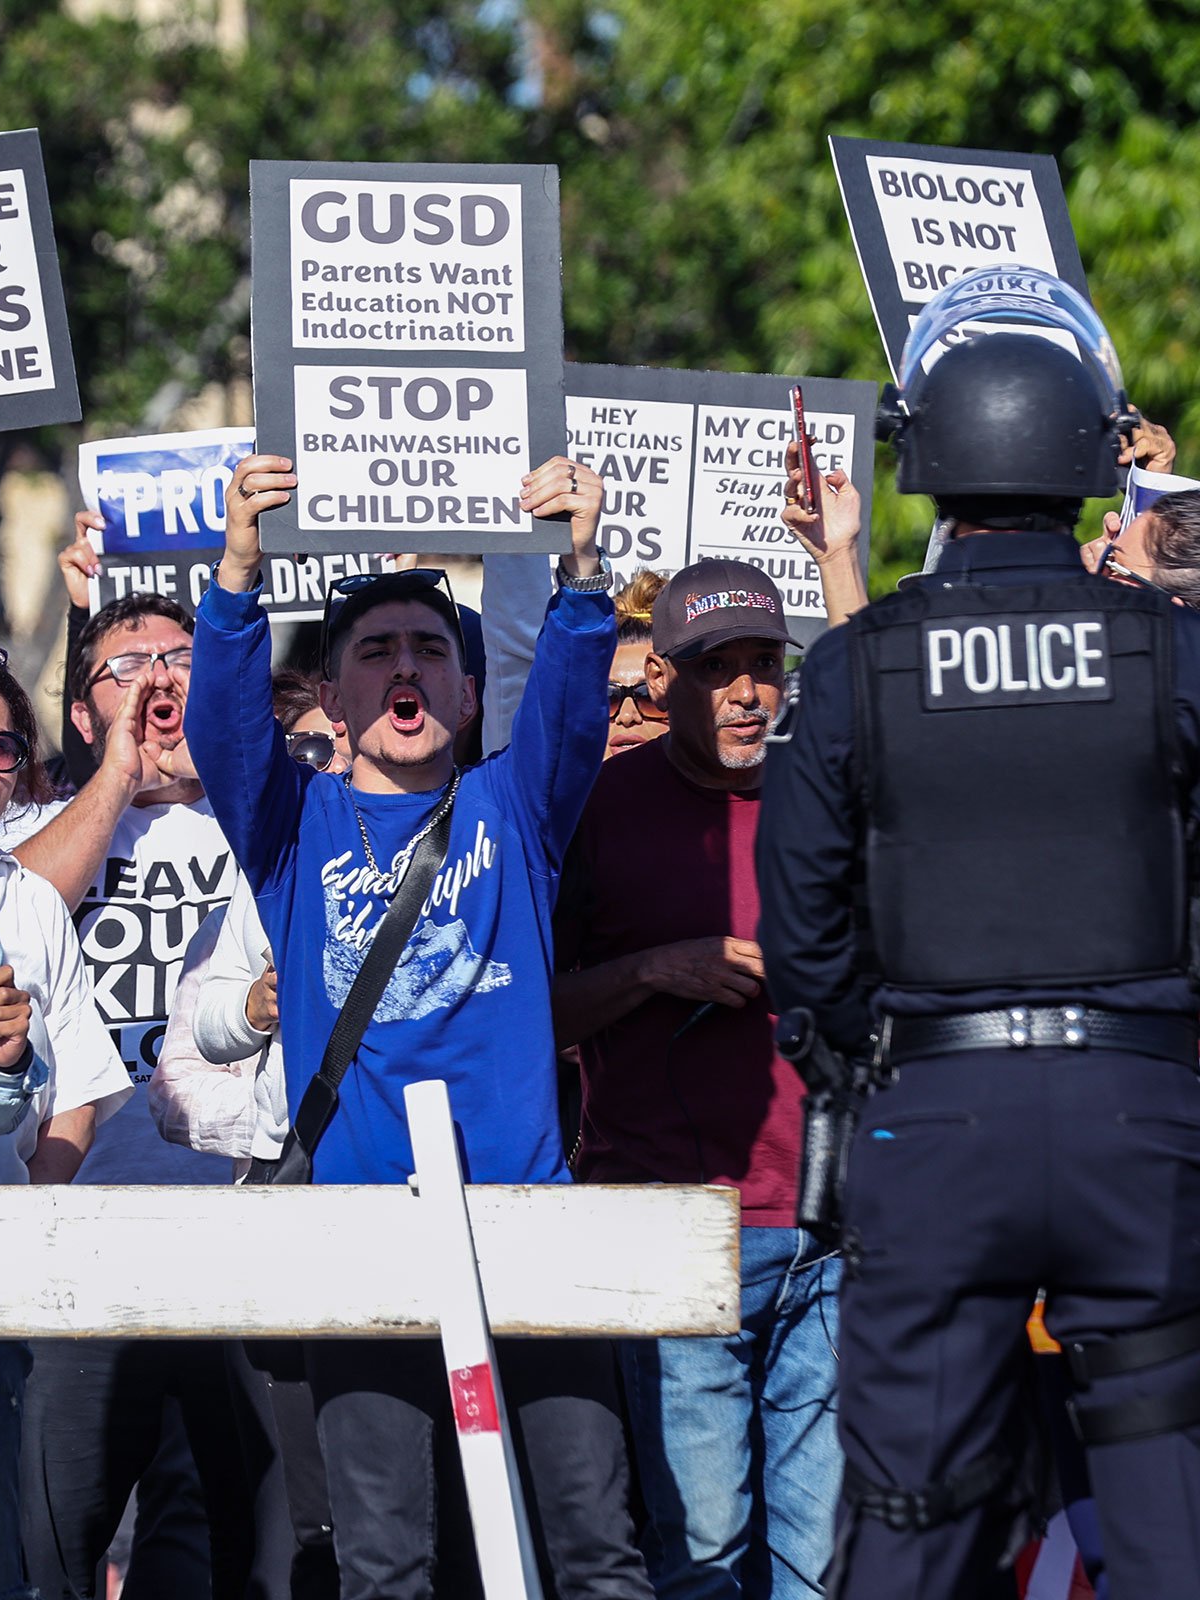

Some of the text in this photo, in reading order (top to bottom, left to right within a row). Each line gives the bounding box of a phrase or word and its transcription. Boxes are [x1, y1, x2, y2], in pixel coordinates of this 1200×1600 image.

[879, 169, 1025, 208] BIOLOGY
[301, 191, 510, 246] GUSD
[911, 217, 1017, 252] IS NOT
[302, 260, 512, 286] Parents Want
[302, 292, 513, 315] Education NOT
[302, 318, 514, 342] Indoctrination
[329, 376, 493, 421] STOP
[591, 407, 638, 426] HEY
[705, 416, 846, 445] MY CHLD
[303, 434, 521, 455] BRAINWASHING
[703, 446, 844, 472] MY CHCE
[369, 459, 458, 487] OUR
[716, 477, 766, 500] Stay
[308, 494, 520, 524] CHILDREN
[601, 490, 647, 517] UR
[720, 500, 778, 519] From
[107, 565, 177, 601] THE
[928, 622, 1106, 697] POLICE
